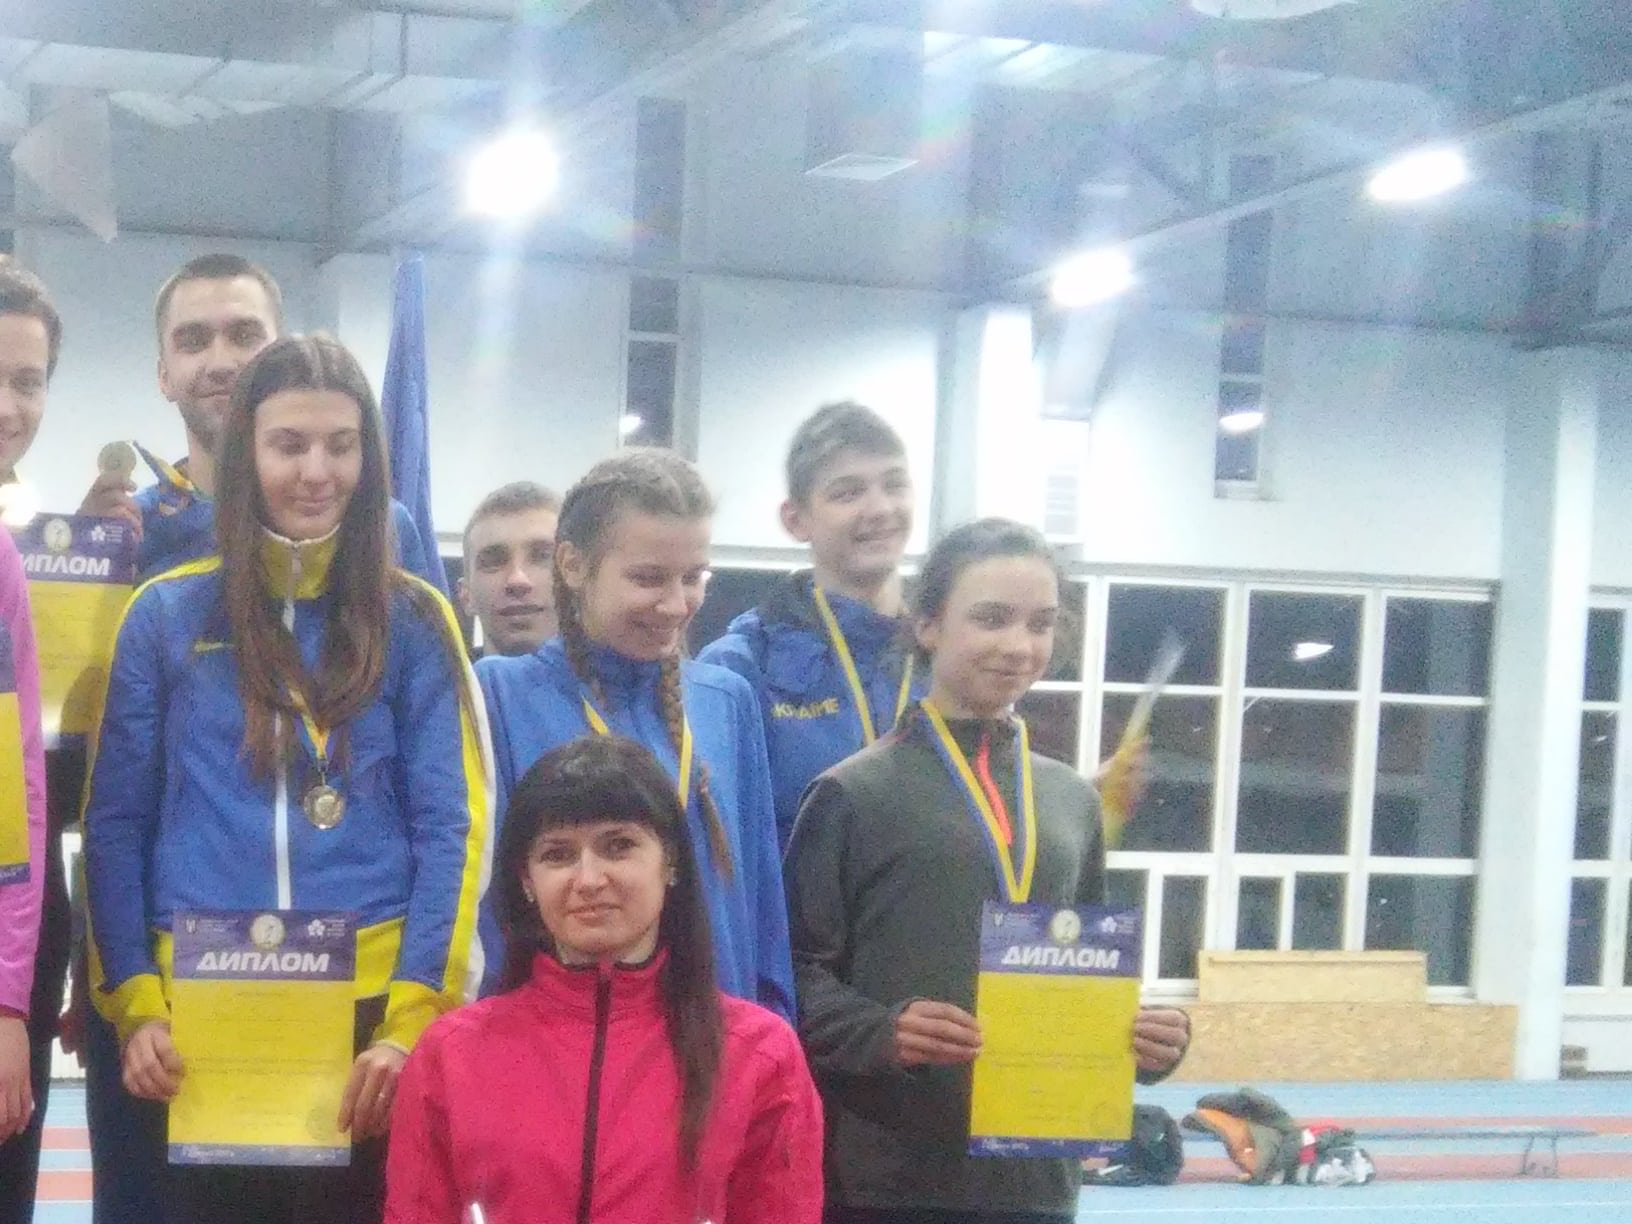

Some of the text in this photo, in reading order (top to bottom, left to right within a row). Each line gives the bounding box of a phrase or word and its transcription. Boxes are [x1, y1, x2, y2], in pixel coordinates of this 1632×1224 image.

[20, 553, 111, 576] ИПЛОМ
[196, 951, 330, 973] ДИПЛОМ
[1001, 945, 1121, 969] ДИПЛОМ
